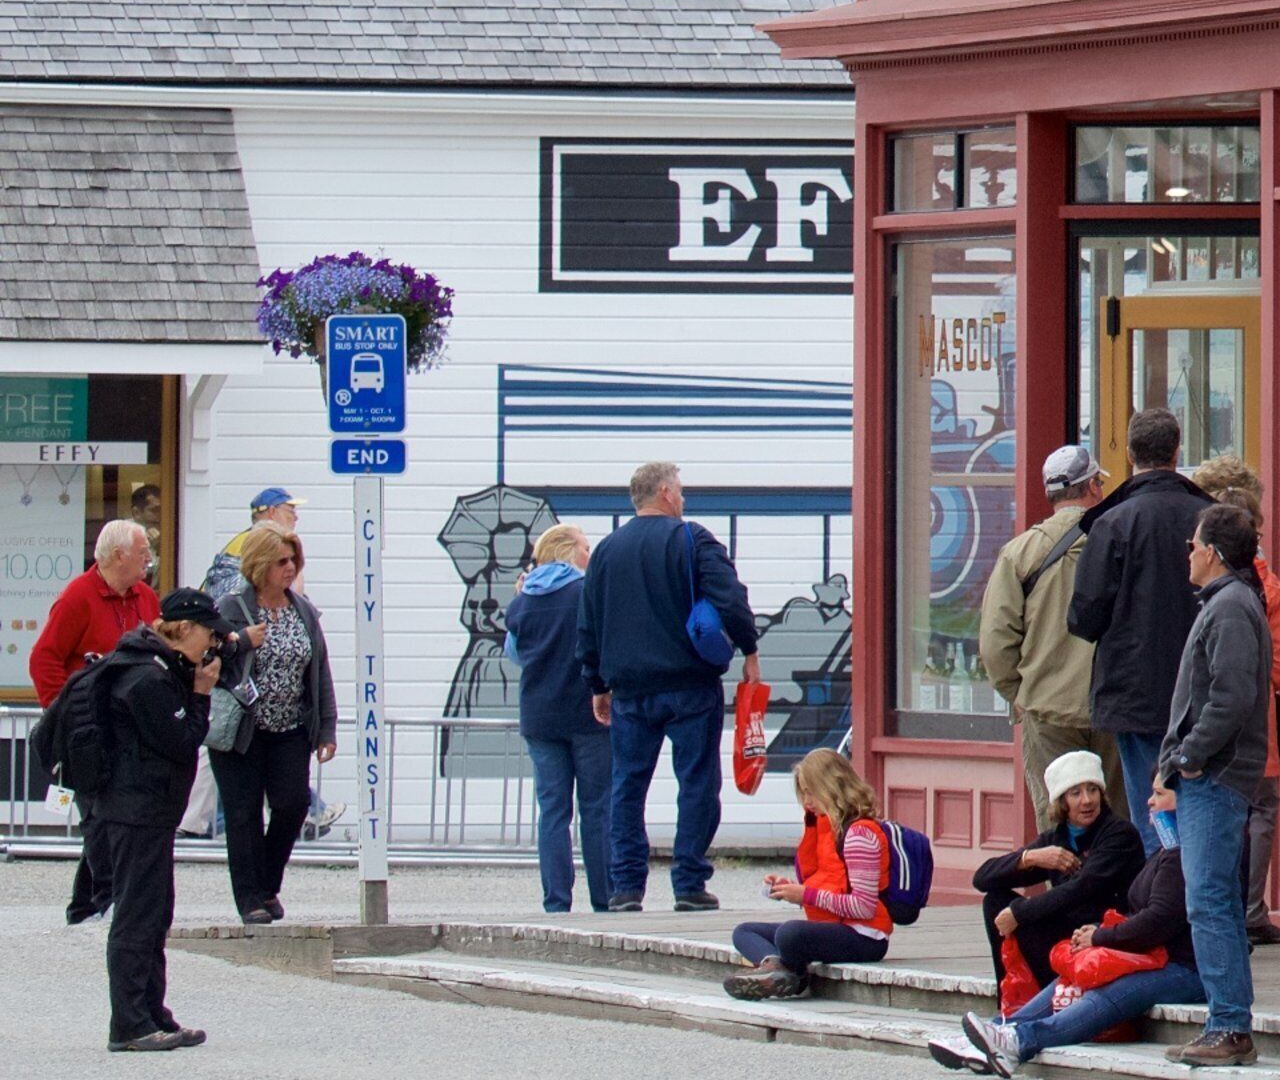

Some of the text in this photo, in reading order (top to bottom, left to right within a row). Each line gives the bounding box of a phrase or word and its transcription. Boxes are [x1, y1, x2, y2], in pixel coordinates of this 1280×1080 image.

[335, 326, 398, 340] SMART
[918, 311, 1005, 377] MASCOT
[39, 445, 99, 461] EFFY
[347, 449, 389, 464] END
[39, 537, 73, 546] OFFER
[363, 519, 379, 839] CITY TRANSIT
